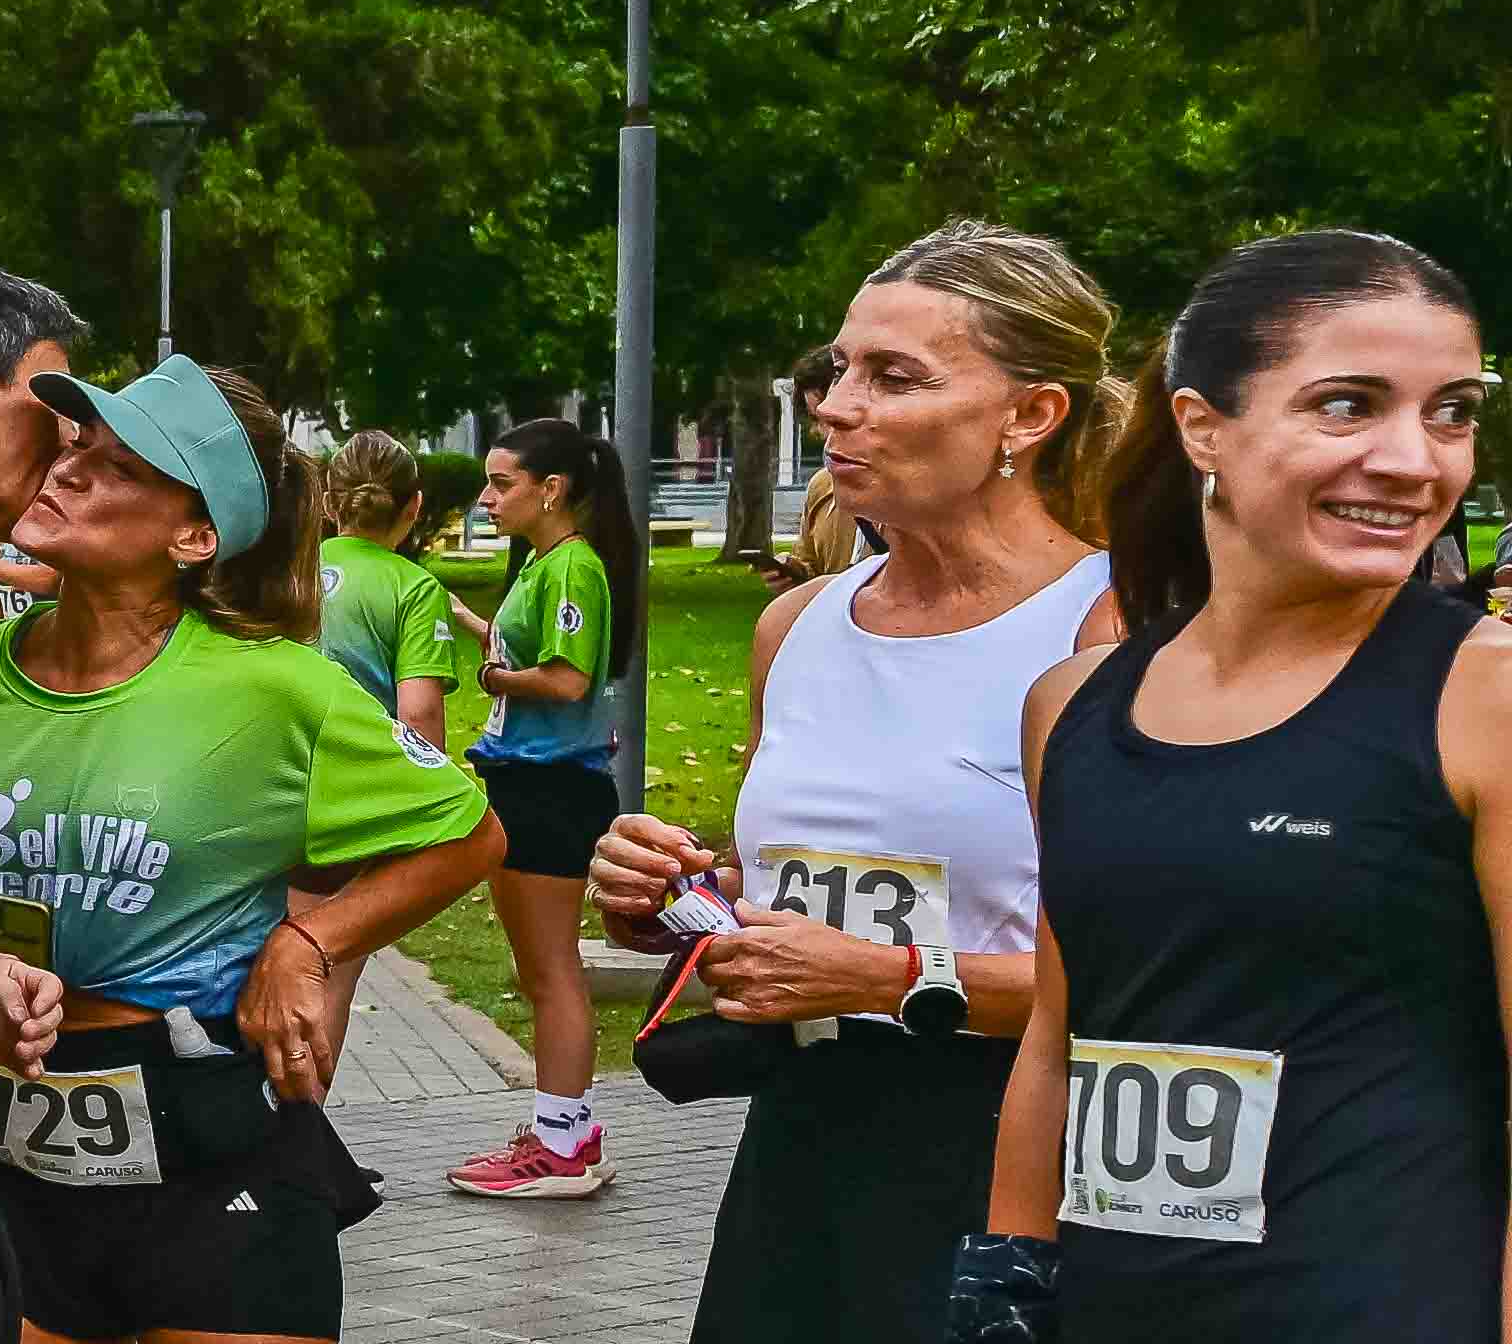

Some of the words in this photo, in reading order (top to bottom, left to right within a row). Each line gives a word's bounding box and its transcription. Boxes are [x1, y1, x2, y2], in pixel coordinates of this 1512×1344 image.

[80, 813, 171, 879] Ville
[770, 859, 916, 946] 613
[1070, 1062, 1242, 1189] 709
[86, 1166, 143, 1177] CARUSO
[1159, 1203, 1241, 1223] CARUSO
